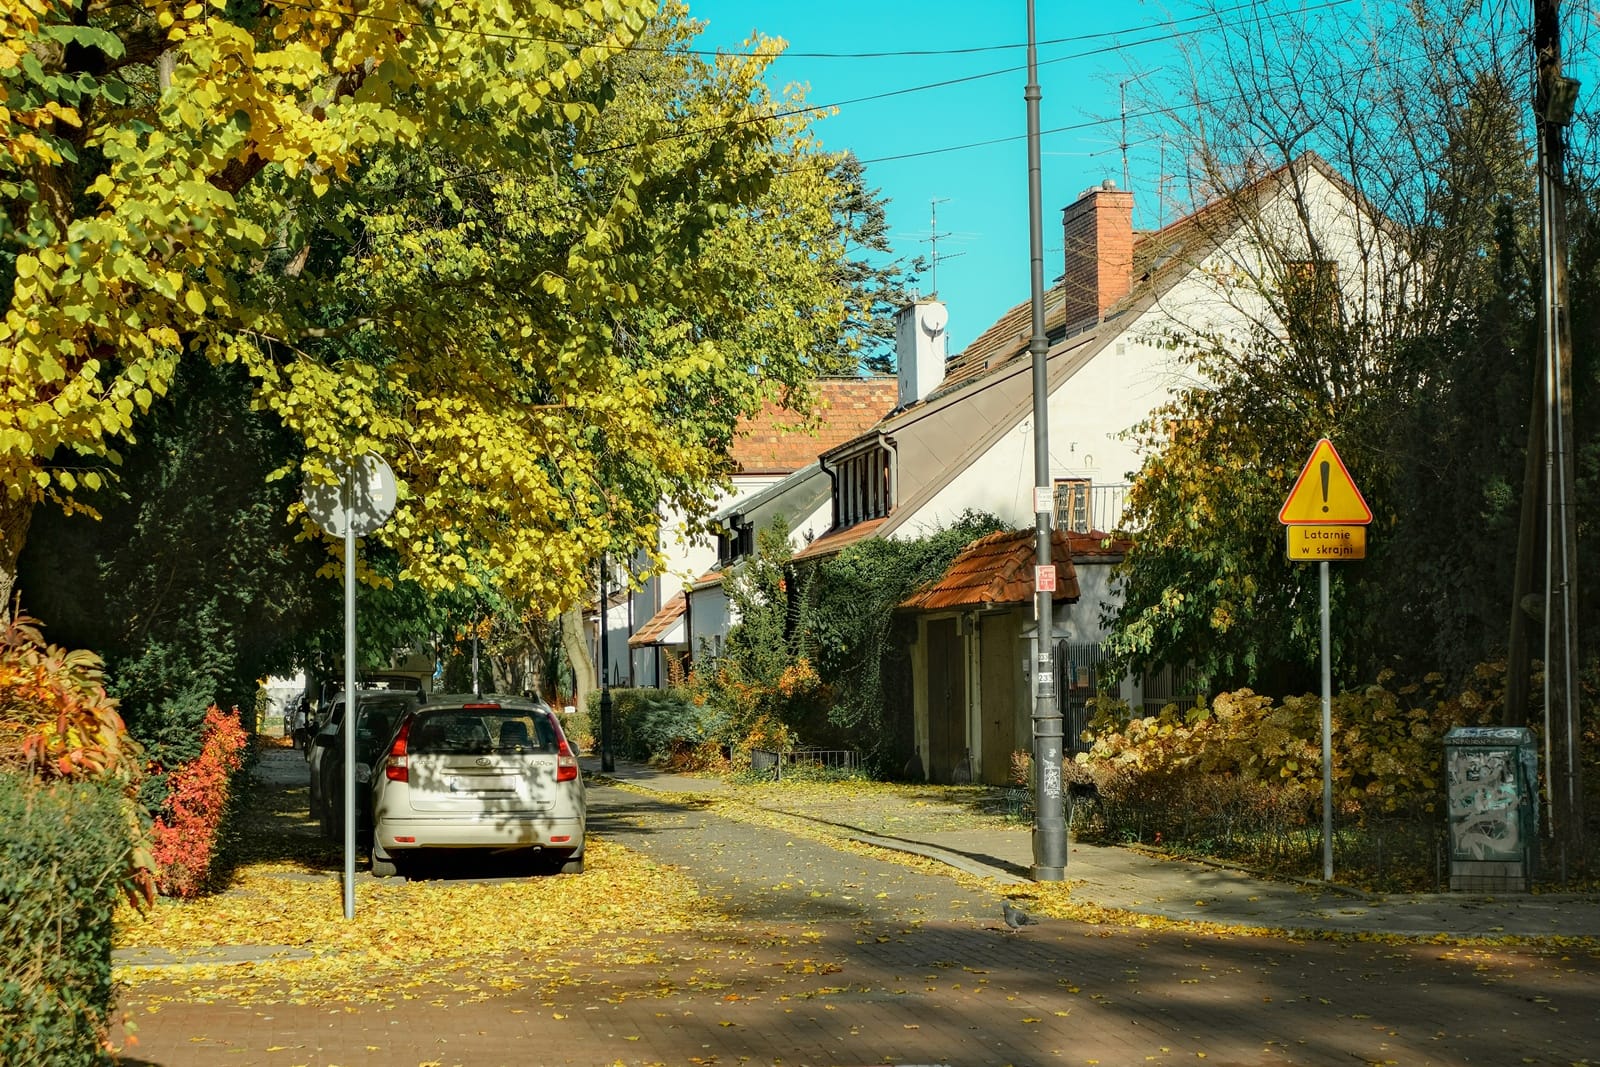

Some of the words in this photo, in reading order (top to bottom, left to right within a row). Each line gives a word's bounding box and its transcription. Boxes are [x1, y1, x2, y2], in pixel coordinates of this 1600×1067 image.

[1304, 529, 1351, 539] Latarnie
[1301, 546, 1310, 554] w
[1316, 544, 1353, 556] skrajni
